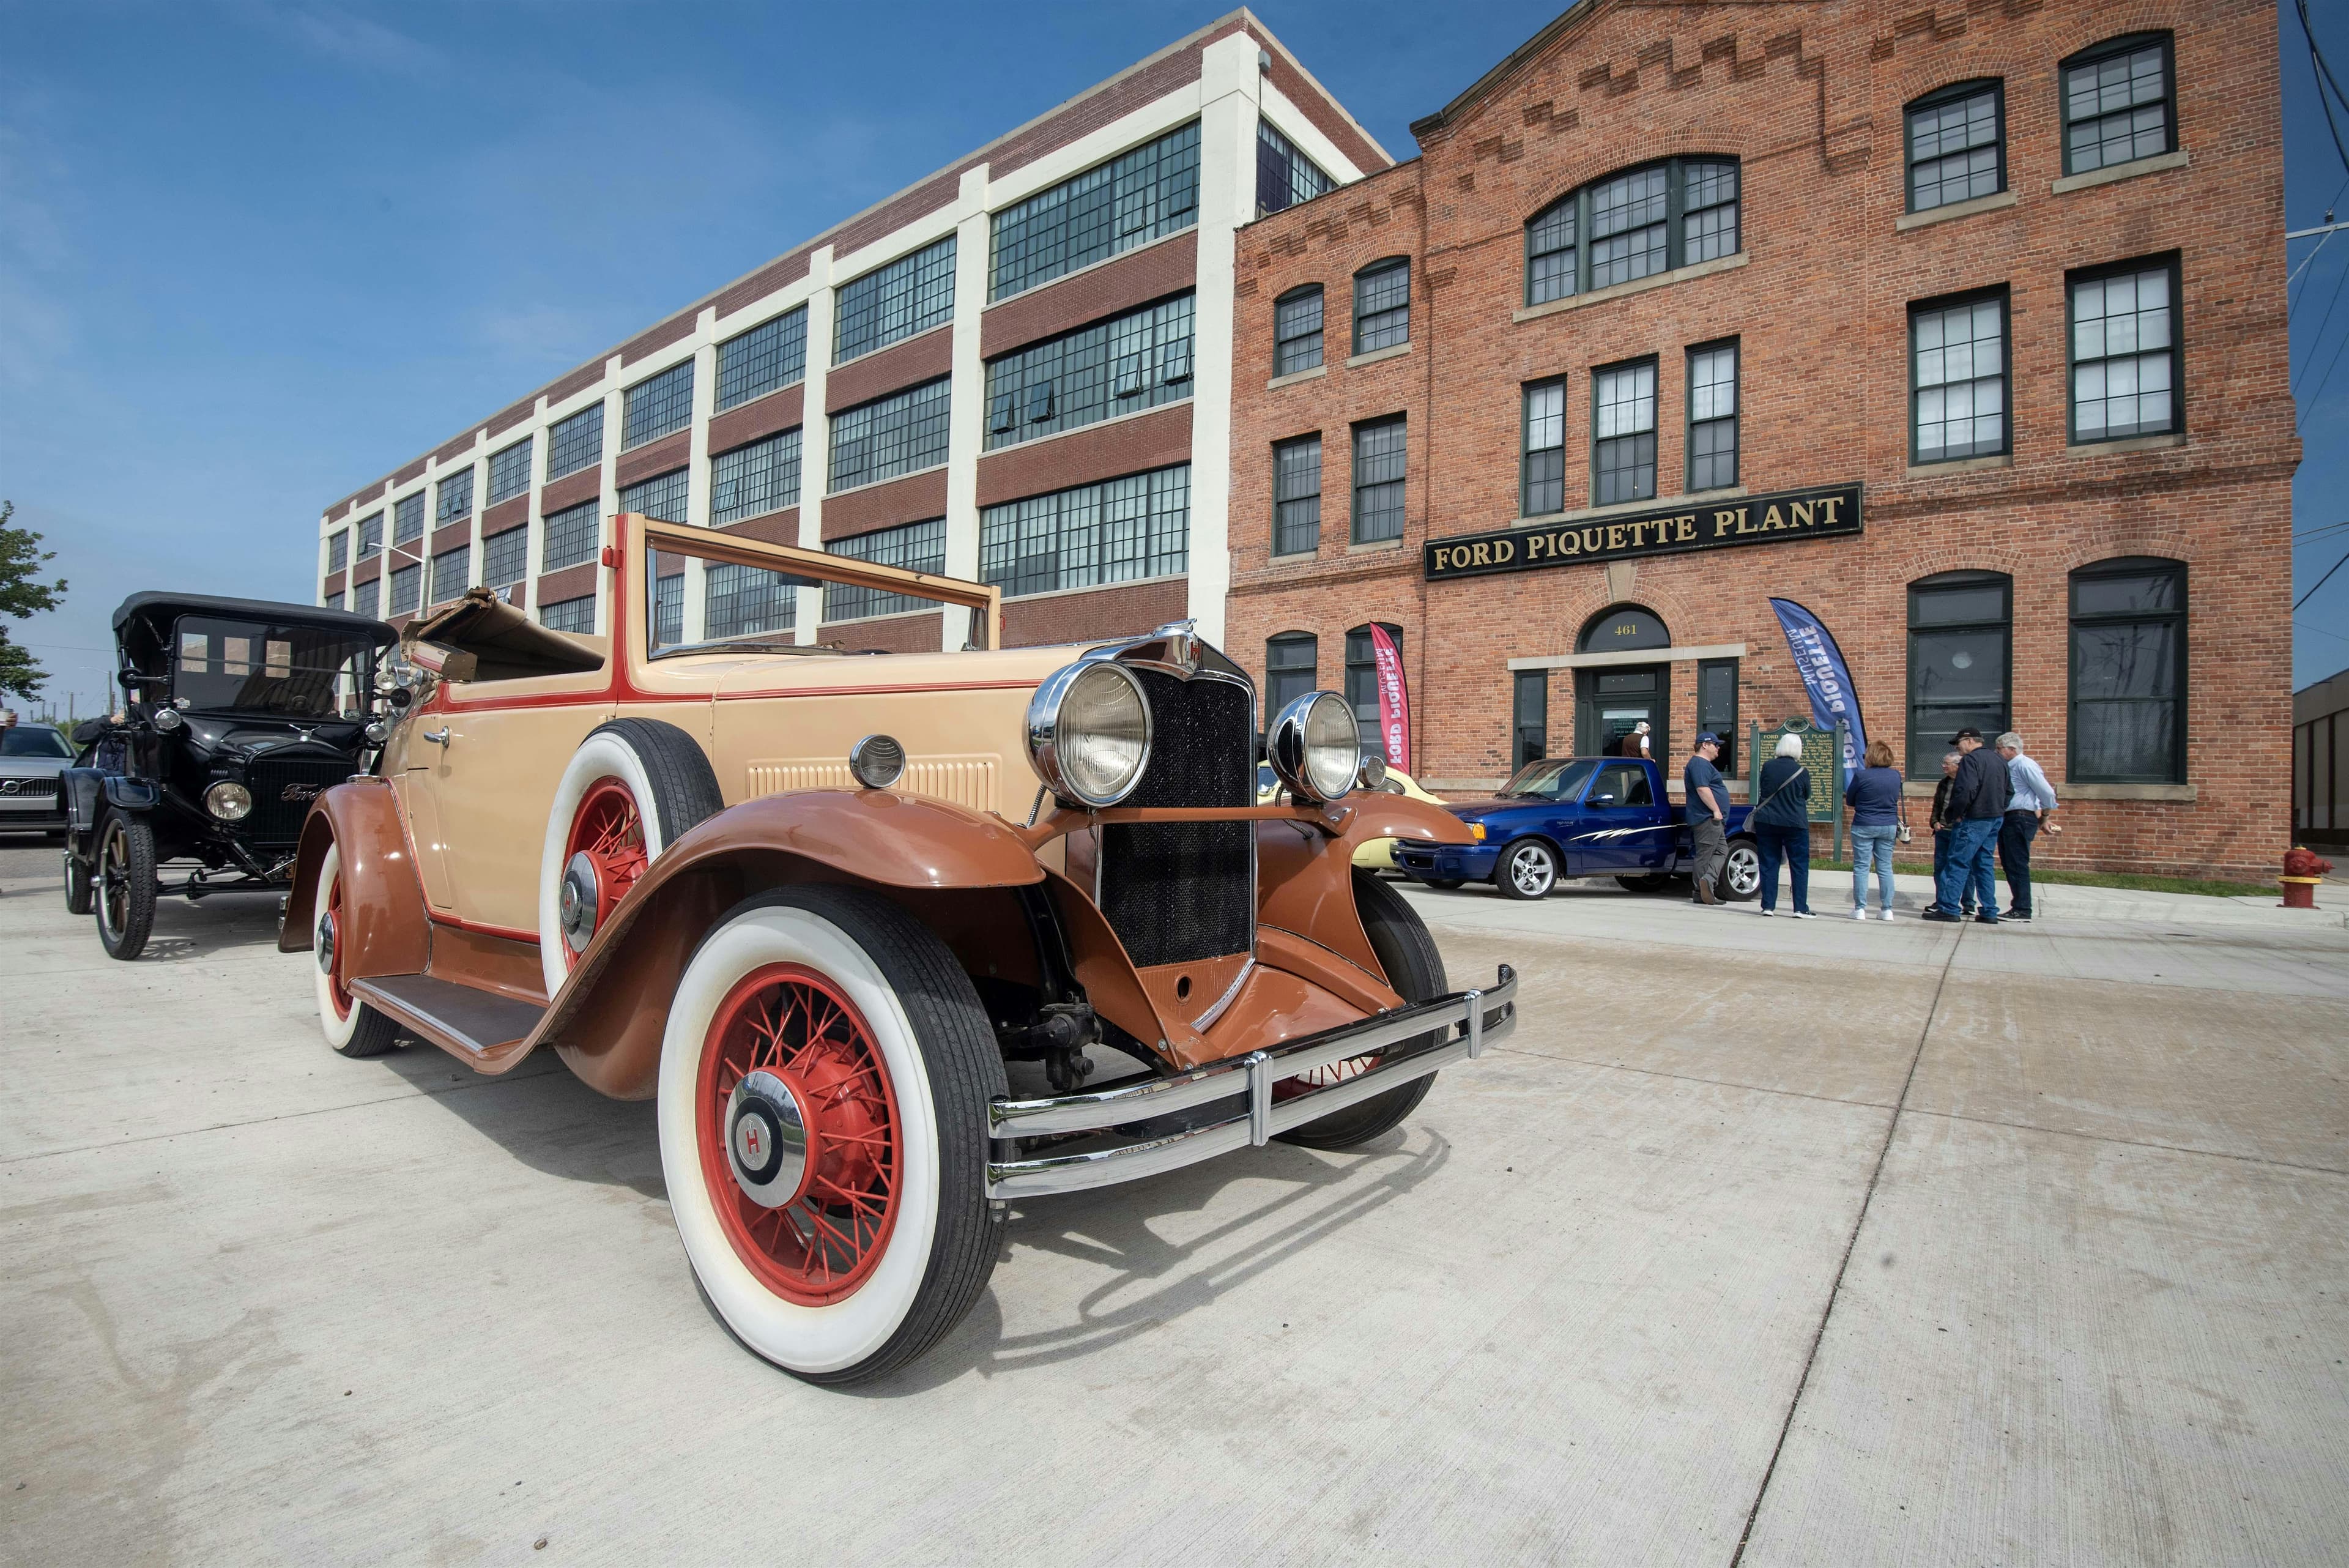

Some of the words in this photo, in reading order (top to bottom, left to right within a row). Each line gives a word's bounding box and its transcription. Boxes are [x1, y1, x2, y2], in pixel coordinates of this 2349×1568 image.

[1434, 540, 1515, 570] FORD
[1527, 515, 1698, 559] PIQUETTE
[1714, 496, 1844, 537] PLANT
[1614, 625, 1637, 636] 461
[746, 1128, 760, 1156] H
